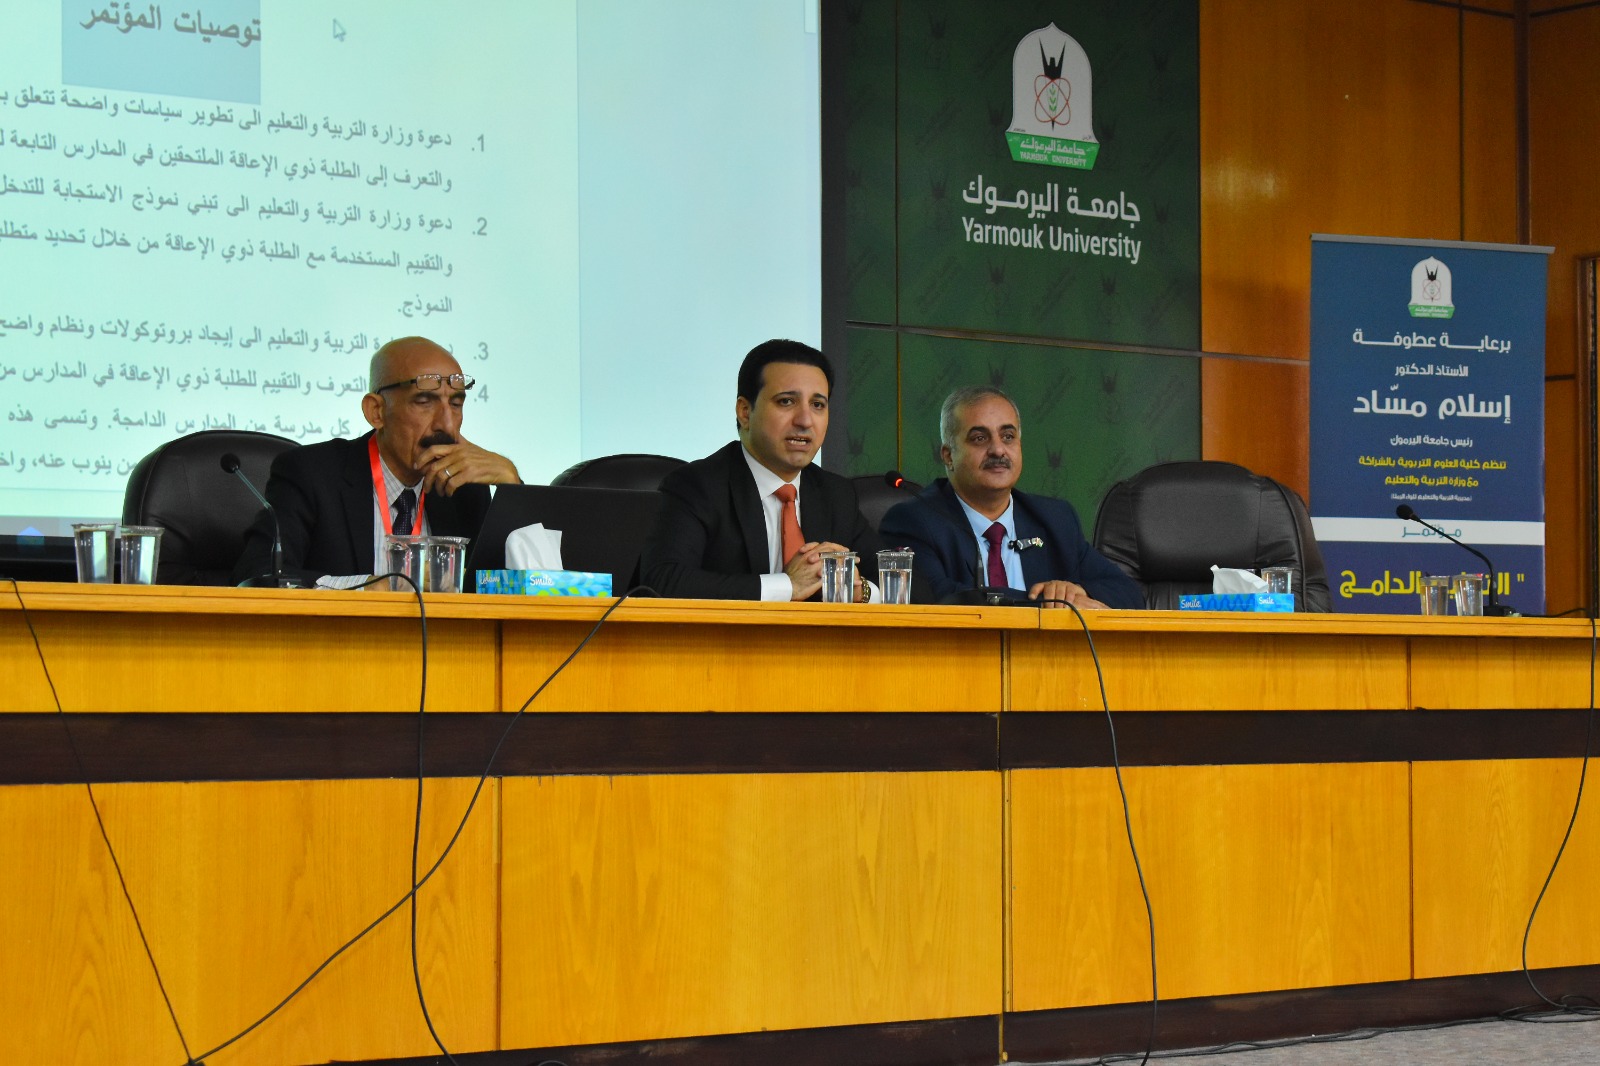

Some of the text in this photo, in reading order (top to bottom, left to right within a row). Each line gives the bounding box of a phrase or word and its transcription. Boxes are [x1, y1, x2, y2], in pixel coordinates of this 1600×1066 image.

[80, 1, 262, 48] توصيات المؤتمر
[15, 85, 55, 108] تتعلق
[60, 89, 119, 117] واضحة
[124, 98, 182, 122] سياسات
[188, 105, 234, 127] تطوير
[267, 111, 318, 137] والتعليم
[323, 116, 366, 140] التربية
[372, 125, 414, 147] وزارة
[10, 128, 56, 153] التابعة
[63, 138, 126, 160] المدارس
[418, 130, 452, 149] دعوة
[133, 143, 154, 166] في
[160, 145, 224, 167] الملتحقين
[229, 151, 278, 178] الإعاقة
[284, 157, 316, 181] ذوي
[321, 158, 361, 180] الطلبة
[394, 168, 452, 192] والتعرف
[53, 179, 123, 203] الاستجابة
[132, 187, 179, 211] نموذج
[962, 174, 1141, 229] جامعة اليرموك
[188, 194, 218, 215] تبني
[258, 198, 310, 222] والتعليم
[317, 201, 361, 225] التربية
[369, 209, 411, 230] وزارة
[418, 213, 452, 233] دعوة
[45, 227, 86, 248] تحديد
[92, 227, 131, 249] خلال
[137, 234, 159, 254] من
[165, 233, 214, 260] الإعاقة
[962, 216, 1142, 265] Yarmouk University
[221, 239, 254, 263] ذوي
[259, 239, 300, 262] الطلبة
[306, 248, 325, 269] مع
[331, 245, 400, 268] المستخدمة
[406, 253, 453, 277] والتقييم
[397, 293, 453, 318] النموذج.
[50, 315, 95, 339] ونظام
[100, 319, 193, 344] بروتوكولات
[199, 324, 233, 348] إيجاد
[268, 326, 319, 351] والتعليم
[324, 330, 368, 354] التربية
[1353, 328, 1511, 354] برعاية عطوفة
[23, 361, 87, 383] المدارس
[93, 363, 115, 387] في
[119, 363, 170, 390] الإعاقة
[176, 366, 210, 392] ذوي
[215, 366, 257, 390] للطلبة
[1395, 362, 1469, 377] الأستاذ الدكتور
[262, 371, 312, 395] والتقييم
[8, 404, 33, 422] هذه
[44, 410, 98, 431] وتسمى
[1438, 393, 1511, 424] إسلام
[274, 415, 322, 439] مدرسة
[330, 417, 350, 439] كل
[1422, 434, 1449, 446] جامعة
[72, 455, 112, 475] ينوب
[1358, 455, 1507, 471] تنظم كلية العلوم التربوية بالشراكة
[1385, 474, 1479, 488] مع وزارة التربية والتعليم
[1339, 569, 1421, 599] الدامج
